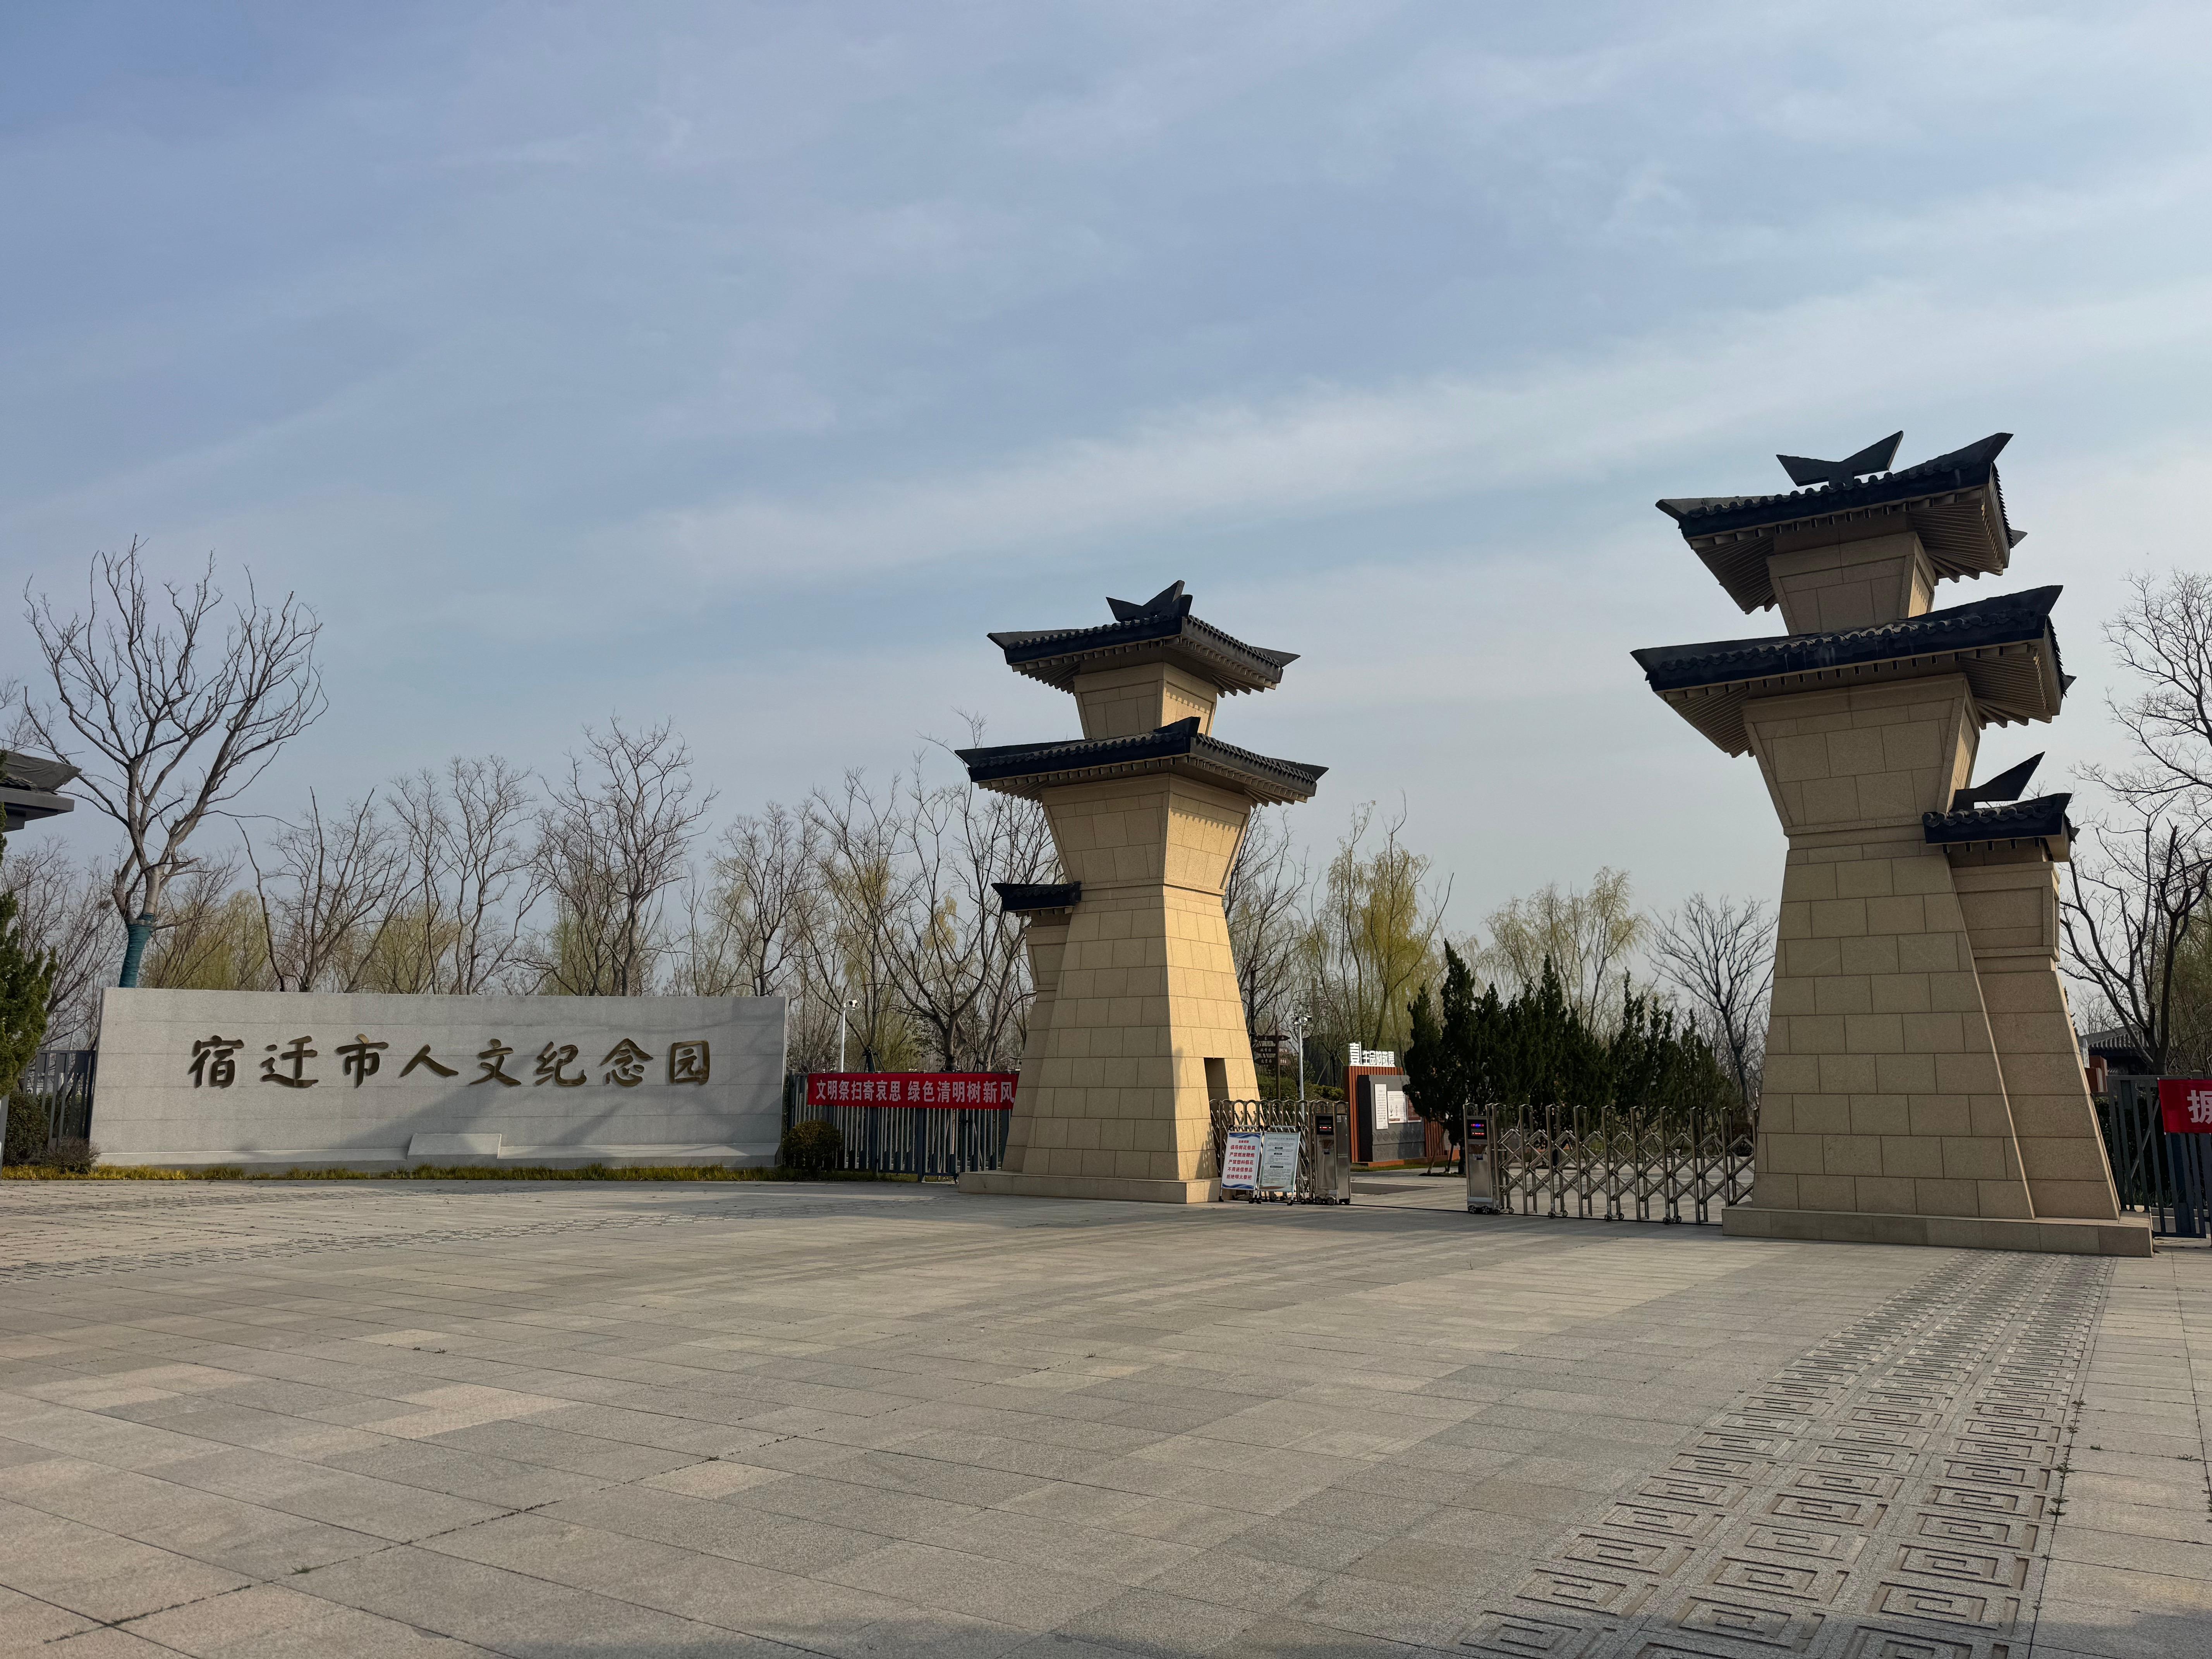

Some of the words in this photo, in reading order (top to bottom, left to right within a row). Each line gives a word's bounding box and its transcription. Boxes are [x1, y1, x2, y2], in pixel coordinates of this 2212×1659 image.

[188, 1033, 710, 1089] 宿迁市人文纪念园
[1362, 1050, 1395, 1066] 生命的敬畏
[816, 1079, 901, 1102] 文明祭扫寄哀思
[907, 1080, 1015, 1103] 绿色清明树新风
